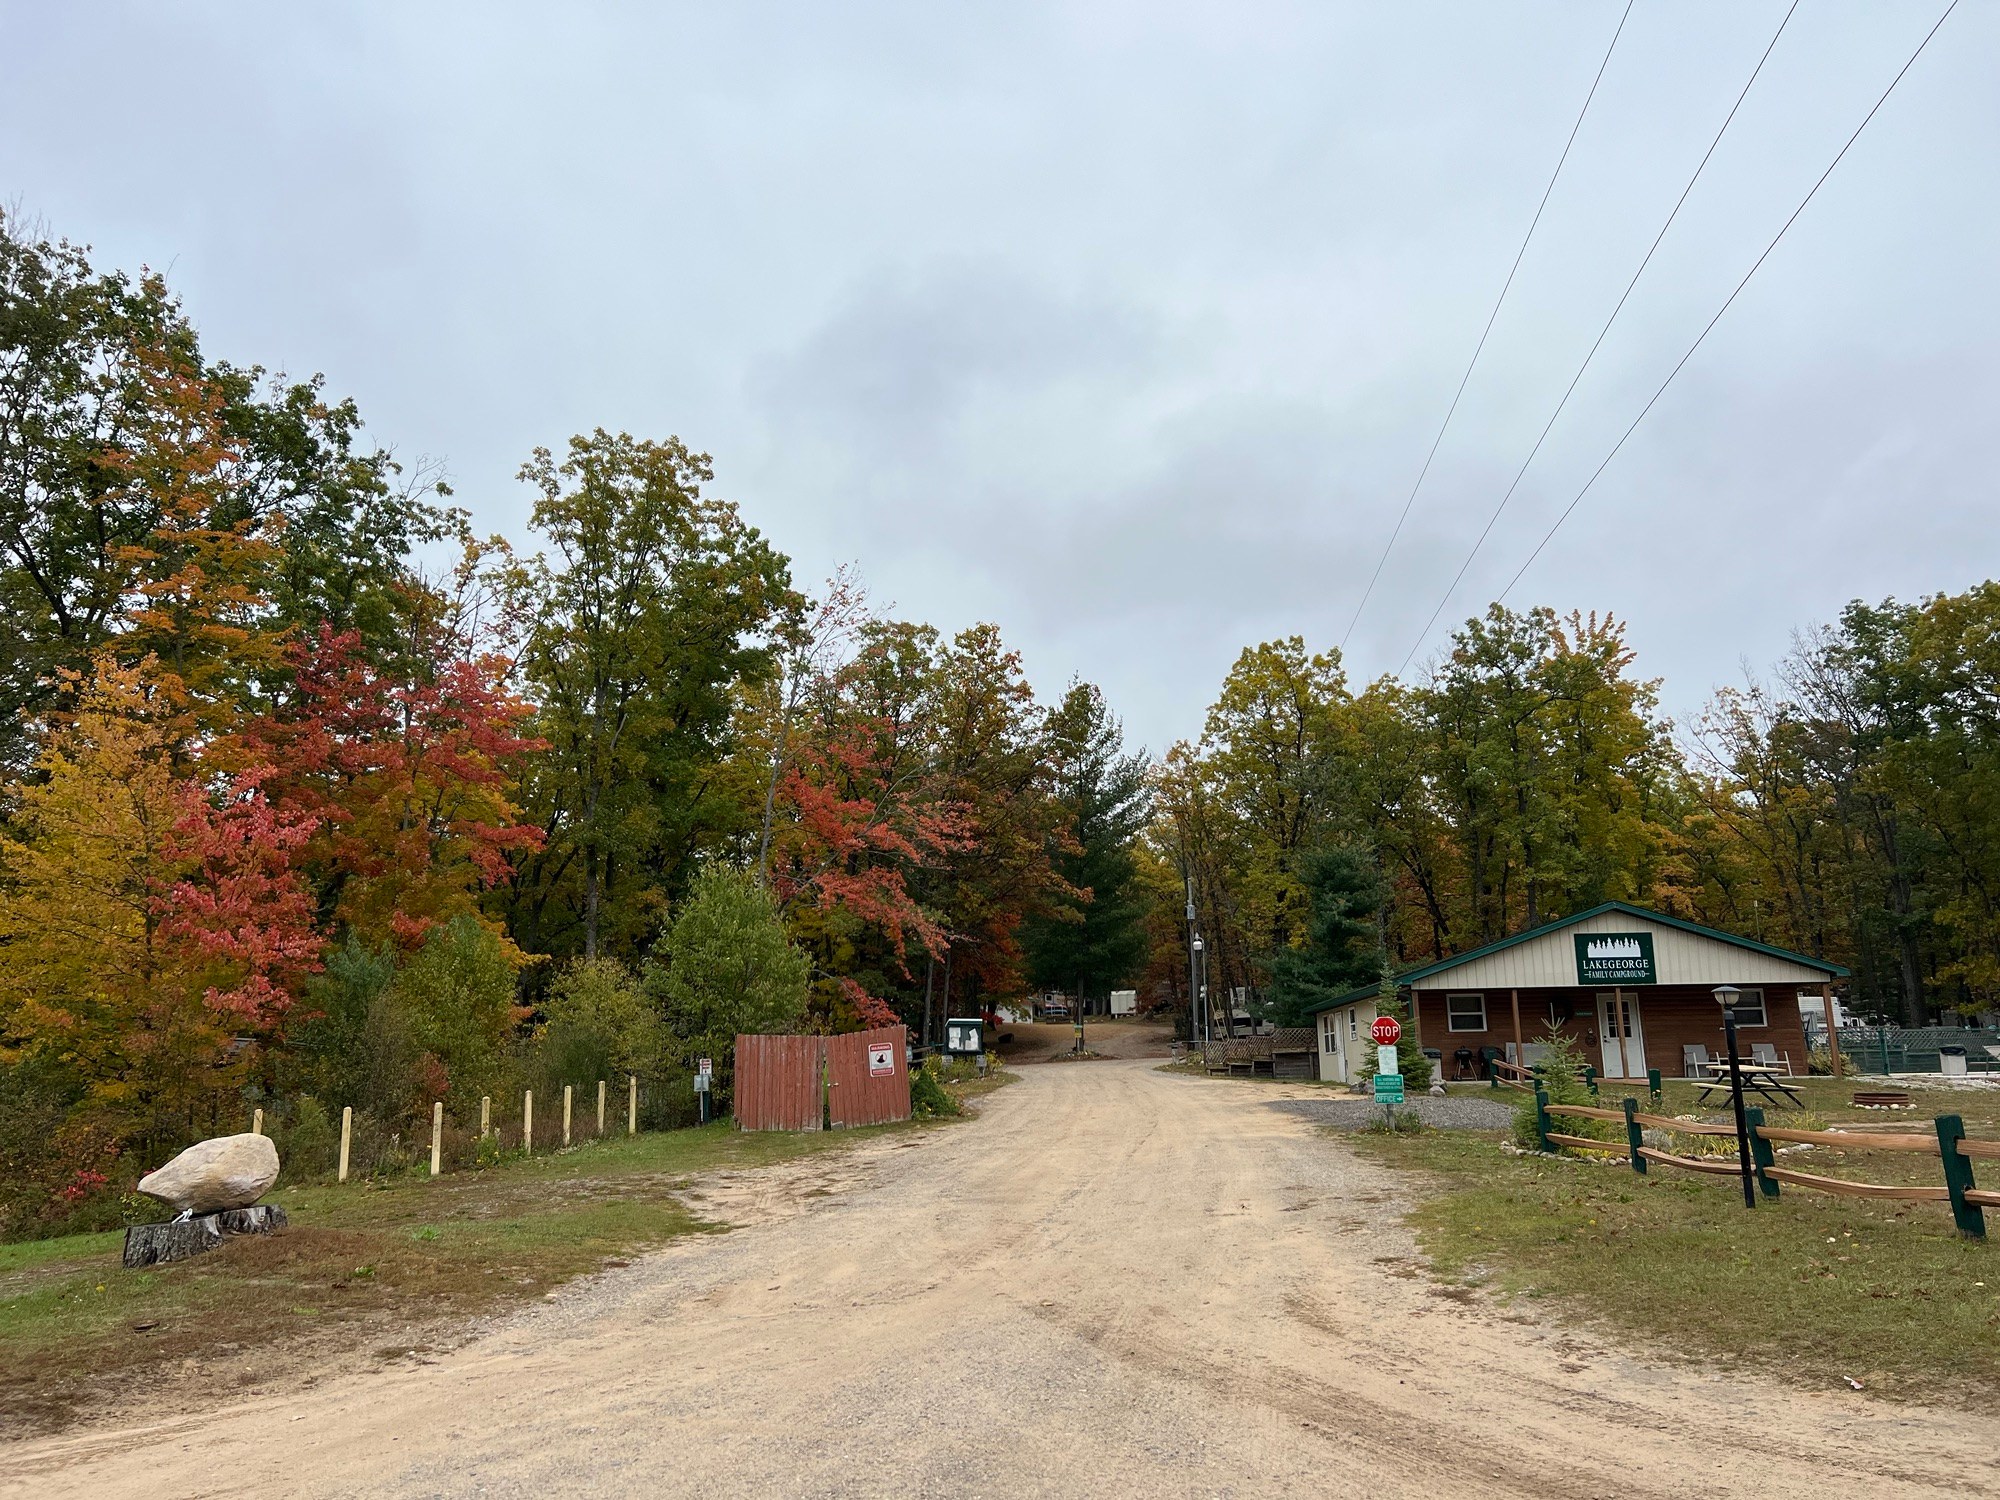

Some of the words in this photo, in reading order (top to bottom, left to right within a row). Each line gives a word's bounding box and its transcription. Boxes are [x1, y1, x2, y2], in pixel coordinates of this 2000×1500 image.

[1588, 970, 1608, 978] FAMILY
[1609, 970, 1646, 978] CAMPGROUND
[1373, 1026, 1399, 1037] STOP
[1376, 1095, 1397, 1103] OFFICE
